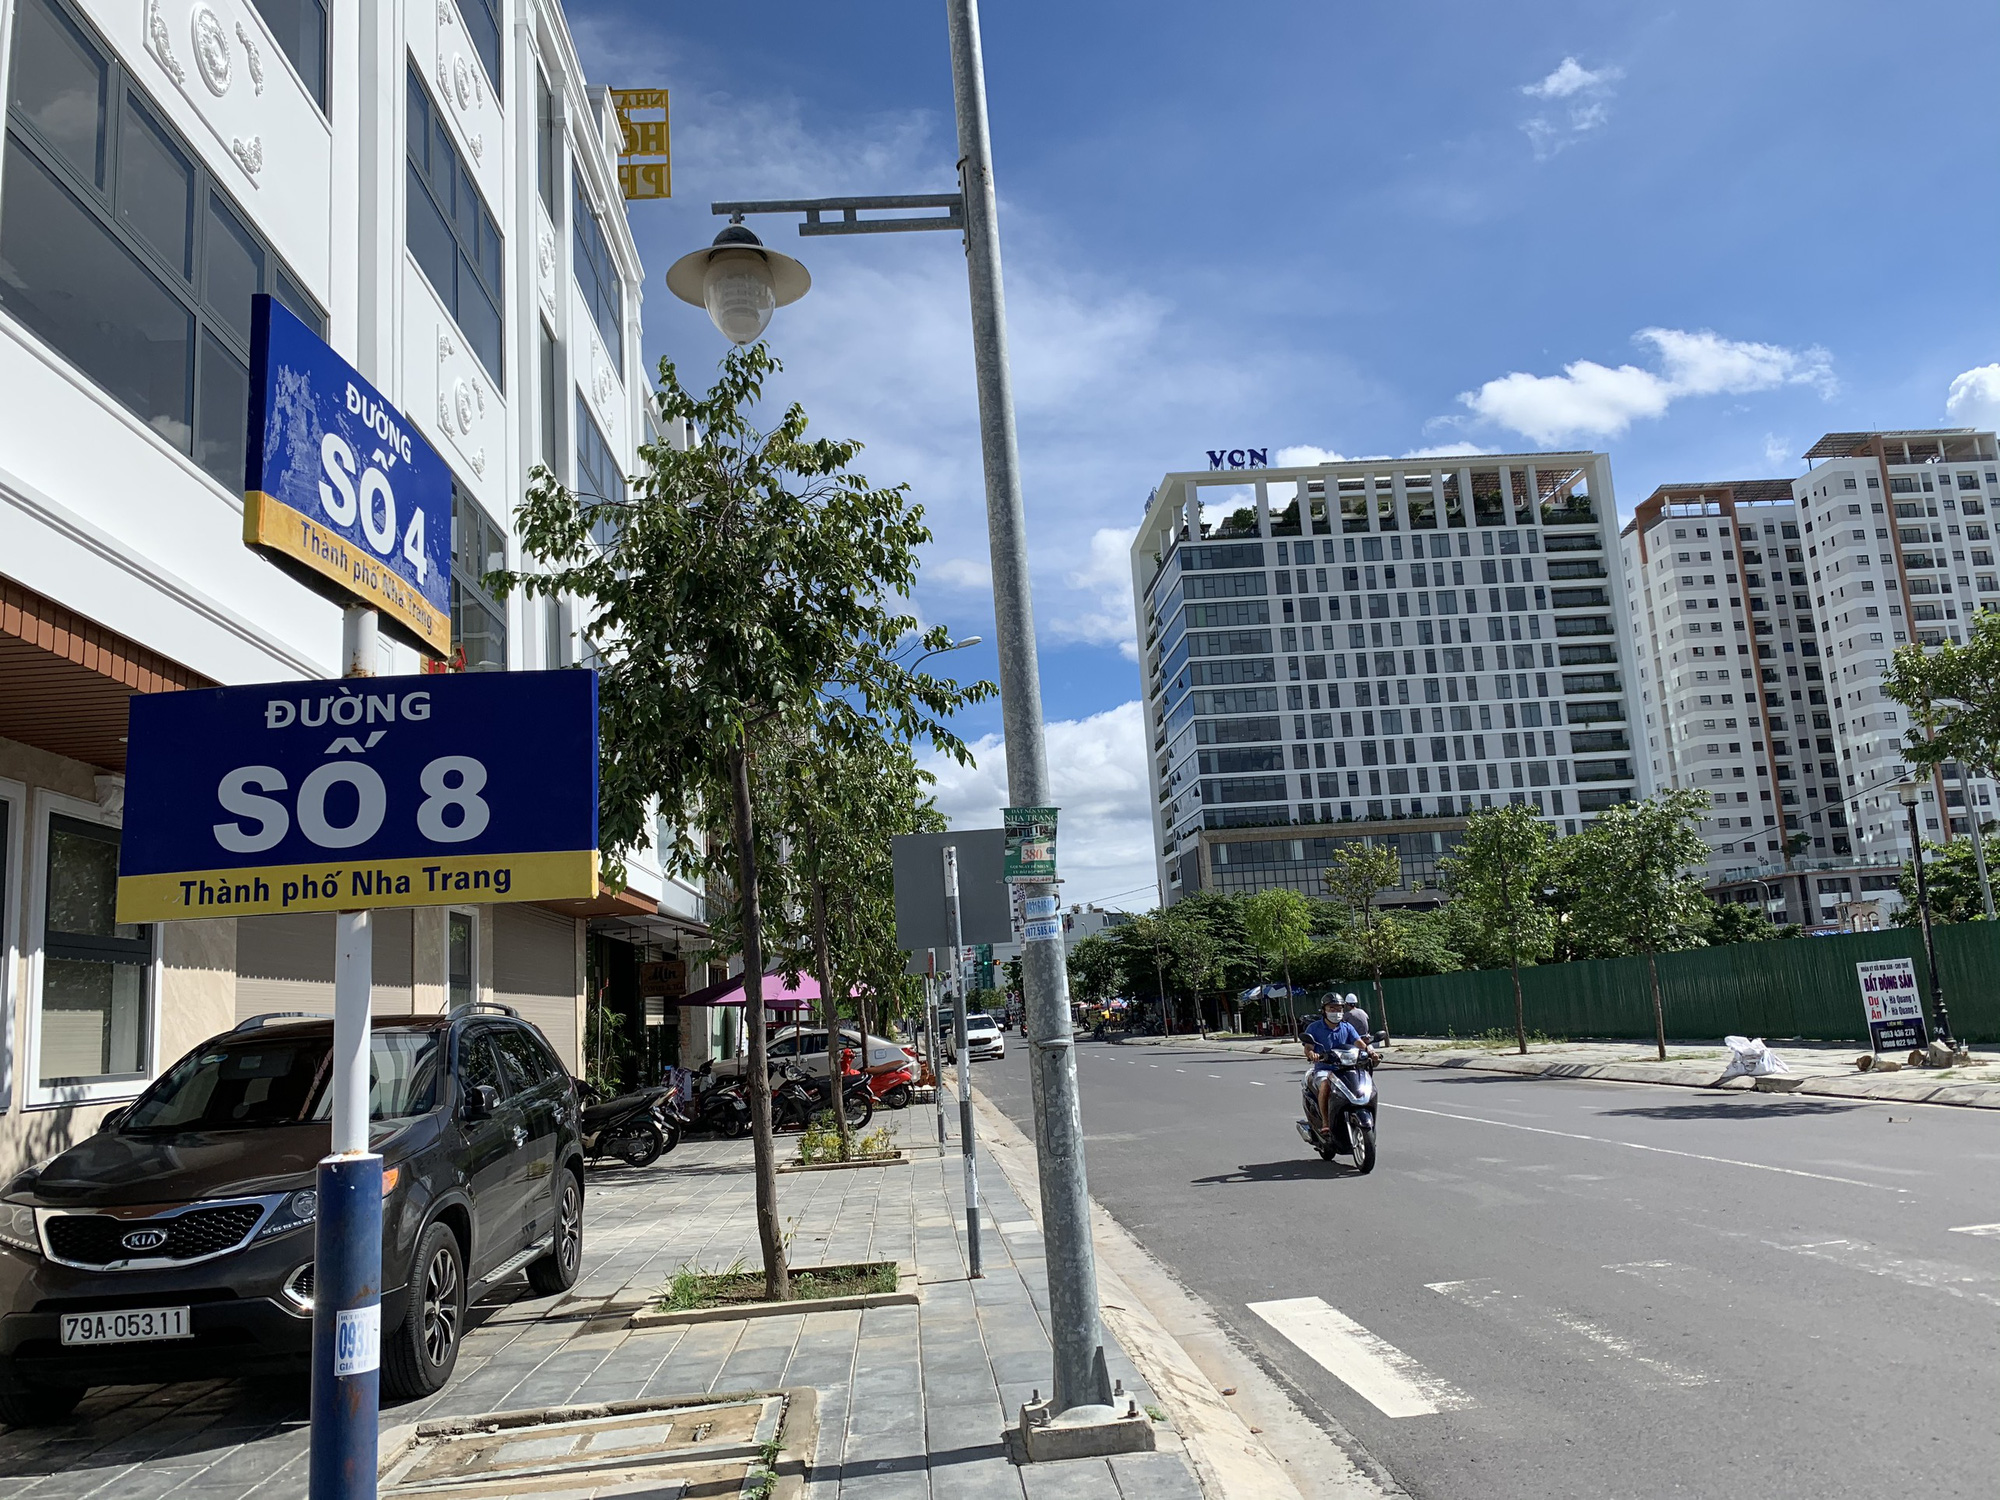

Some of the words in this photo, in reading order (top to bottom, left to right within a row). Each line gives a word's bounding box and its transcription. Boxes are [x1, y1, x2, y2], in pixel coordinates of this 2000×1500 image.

[345, 380, 412, 464] ĐƯỜNG
[1206, 448, 1268, 468] VCN
[319, 433, 397, 555] SỐ
[404, 507, 427, 586] 4
[301, 519, 348, 573] Thành
[353, 558, 379, 590] phố
[406, 592, 433, 636] Trang
[264, 686, 431, 729] ĐƯỜNG
[213, 730, 388, 853] SỐ
[416, 755, 491, 843] 8
[1022, 848, 1043, 860] 380
[180, 877, 270, 906] Thành
[282, 870, 344, 907] phố
[352, 870, 412, 897] Nha
[422, 866, 512, 894] Trang
[1864, 972, 1878, 992] BẤT
[1878, 973, 1898, 993] ĐỘNG
[1898, 970, 1914, 989] SẢN
[131, 1234, 157, 1246] KIA
